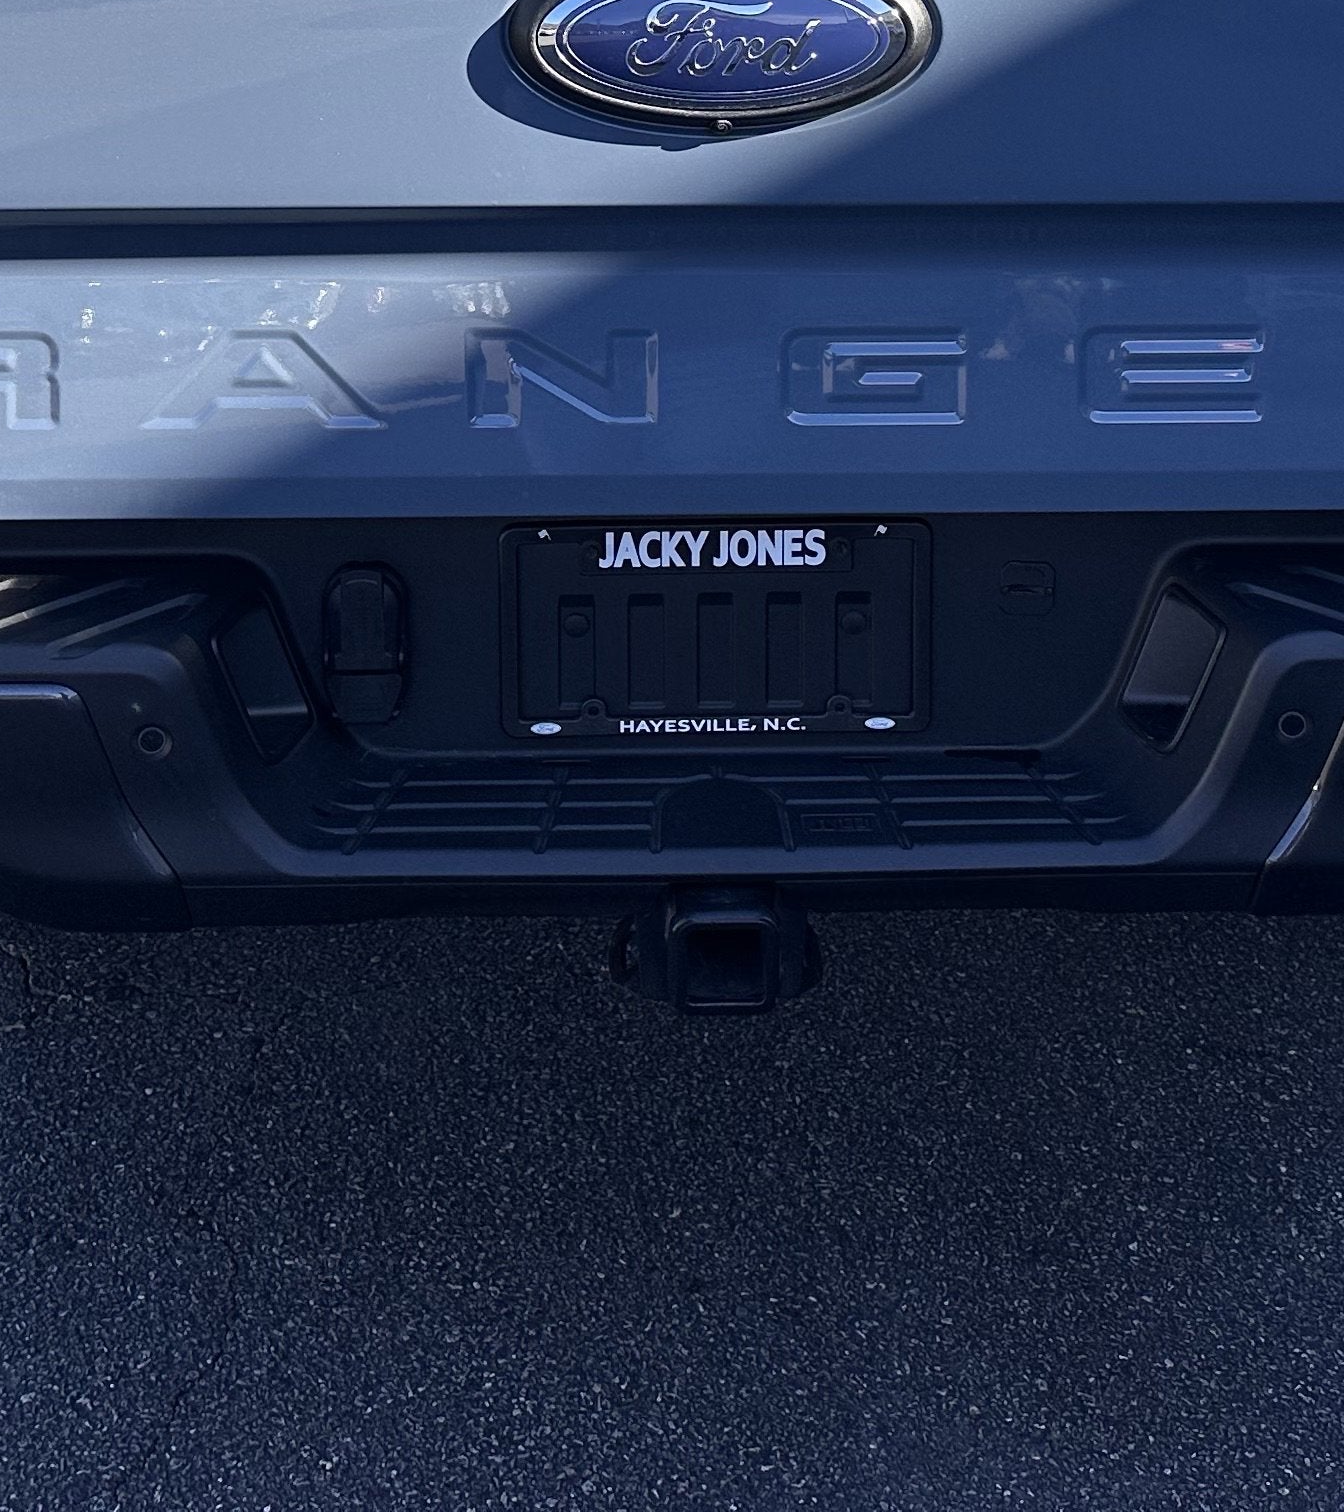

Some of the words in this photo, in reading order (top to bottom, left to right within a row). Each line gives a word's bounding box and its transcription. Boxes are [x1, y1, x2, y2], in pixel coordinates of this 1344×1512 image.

[598, 530, 708, 568] JACKY
[712, 529, 826, 567] JONES
[619, 717, 757, 733] HAYESVILLE,
[763, 716, 806, 731] N.C.
